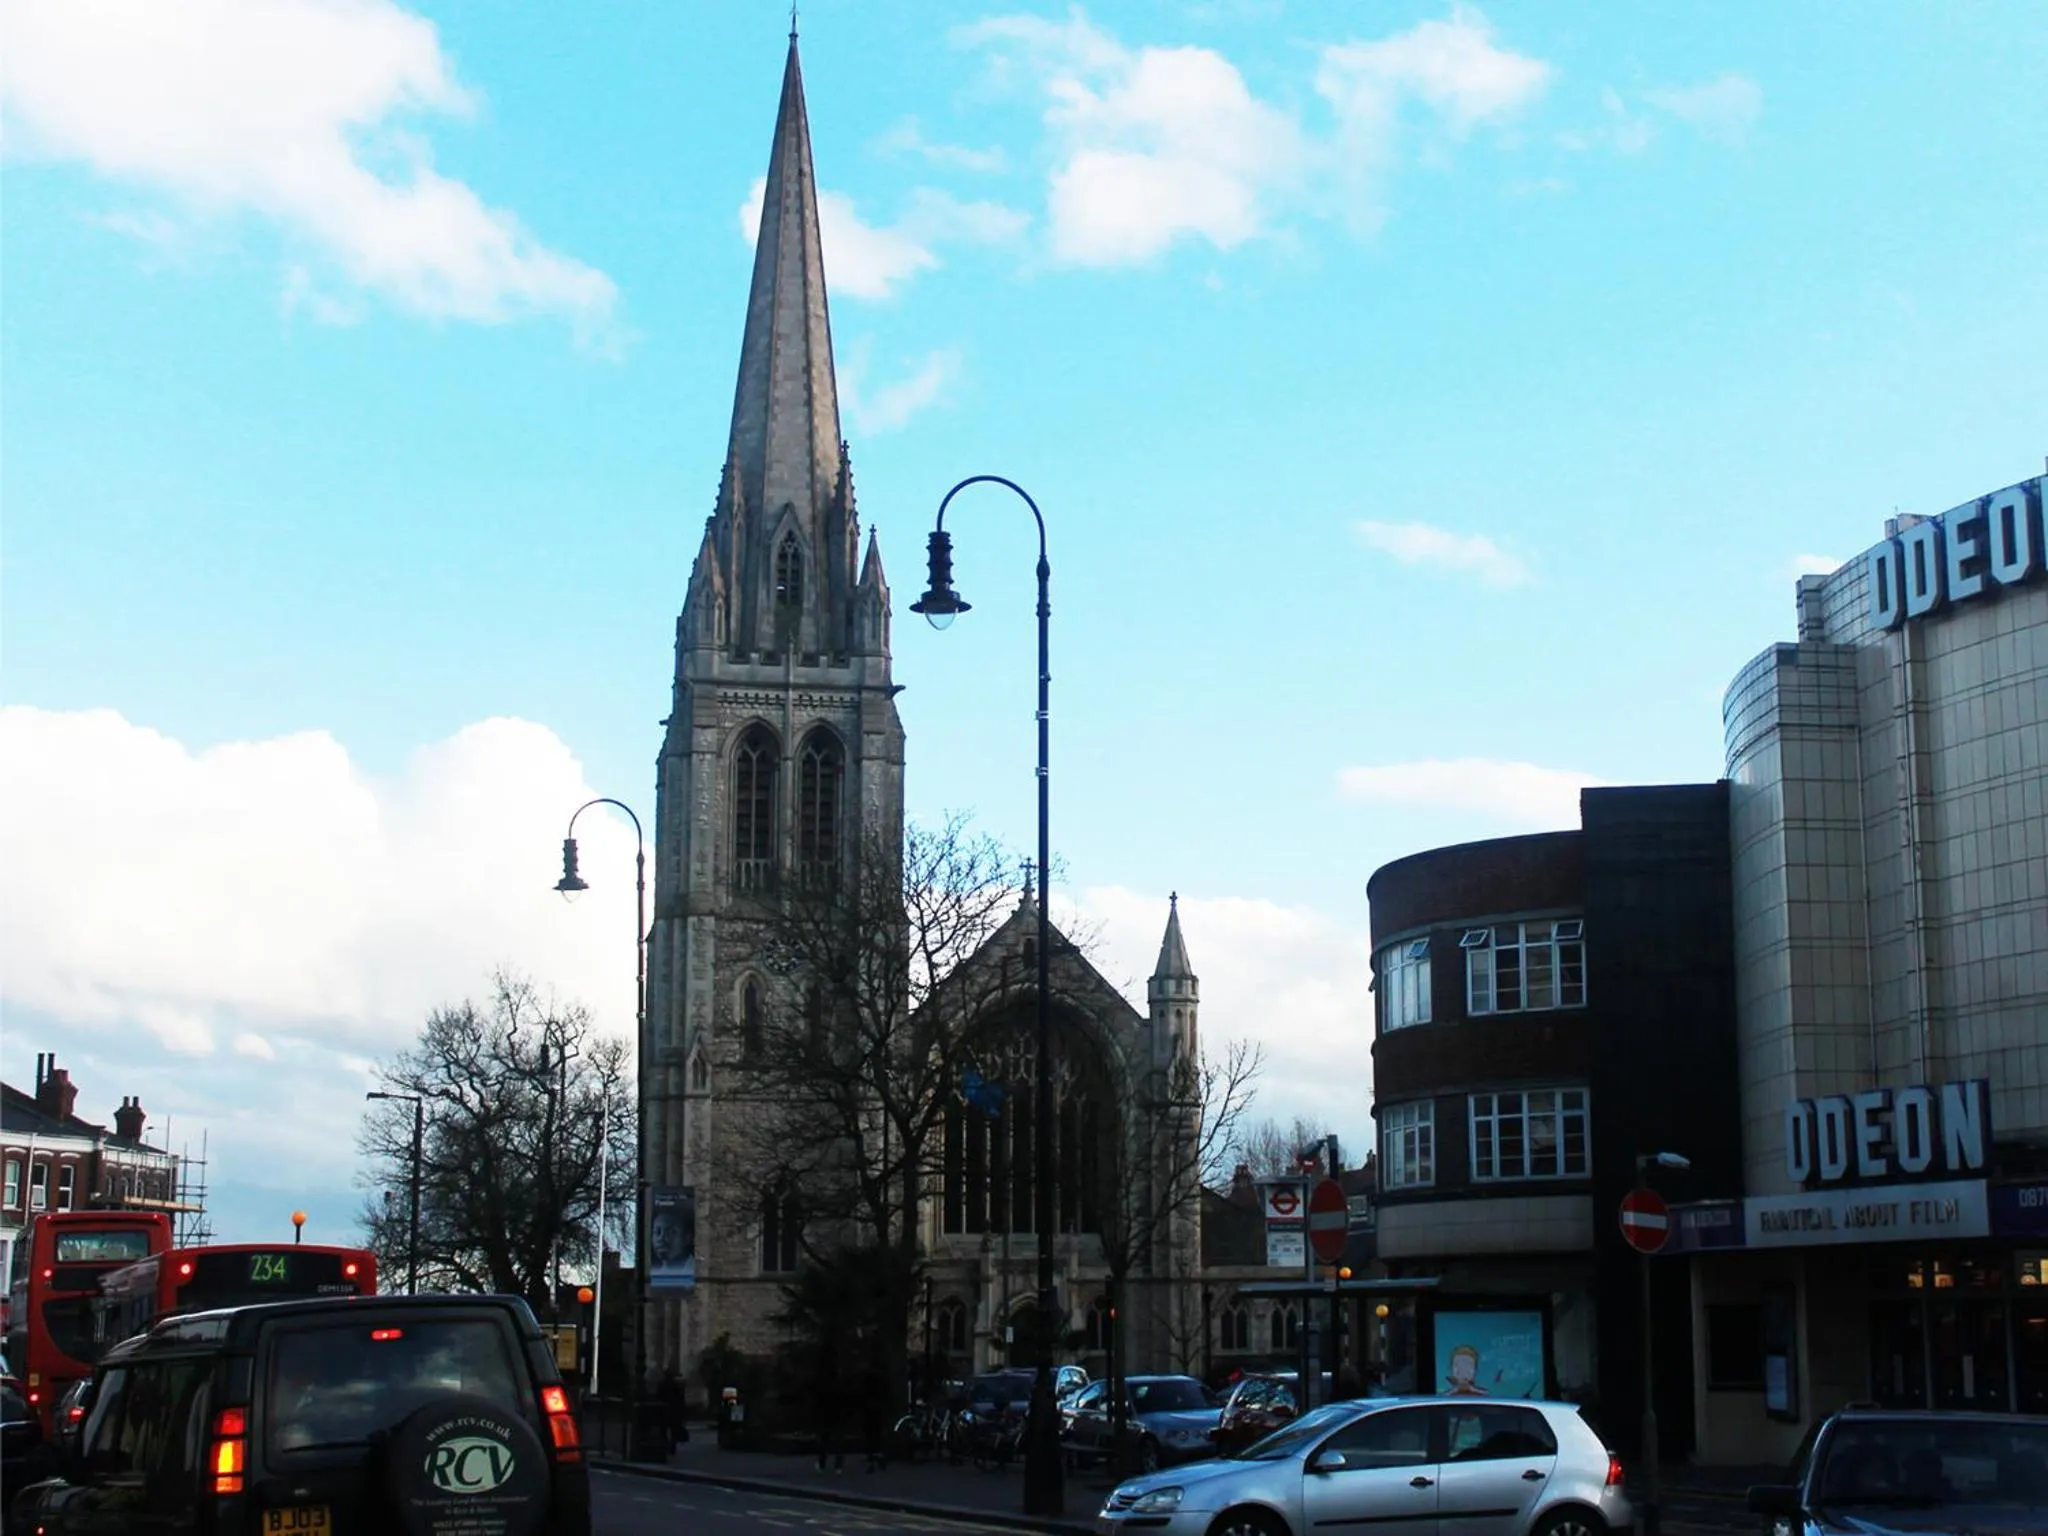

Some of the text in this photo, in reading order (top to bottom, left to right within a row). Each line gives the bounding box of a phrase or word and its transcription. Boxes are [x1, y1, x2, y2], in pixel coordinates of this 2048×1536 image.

[1868, 476, 2048, 631] ODEO
[1786, 1081, 1985, 1182] ODEON
[1845, 1203, 1900, 1229] ABOUT
[1910, 1198, 1959, 1225] FILM
[251, 1254, 286, 1281] 234
[426, 1416, 513, 1441] www.rcv.co.uk
[425, 1446, 513, 1486] RCV
